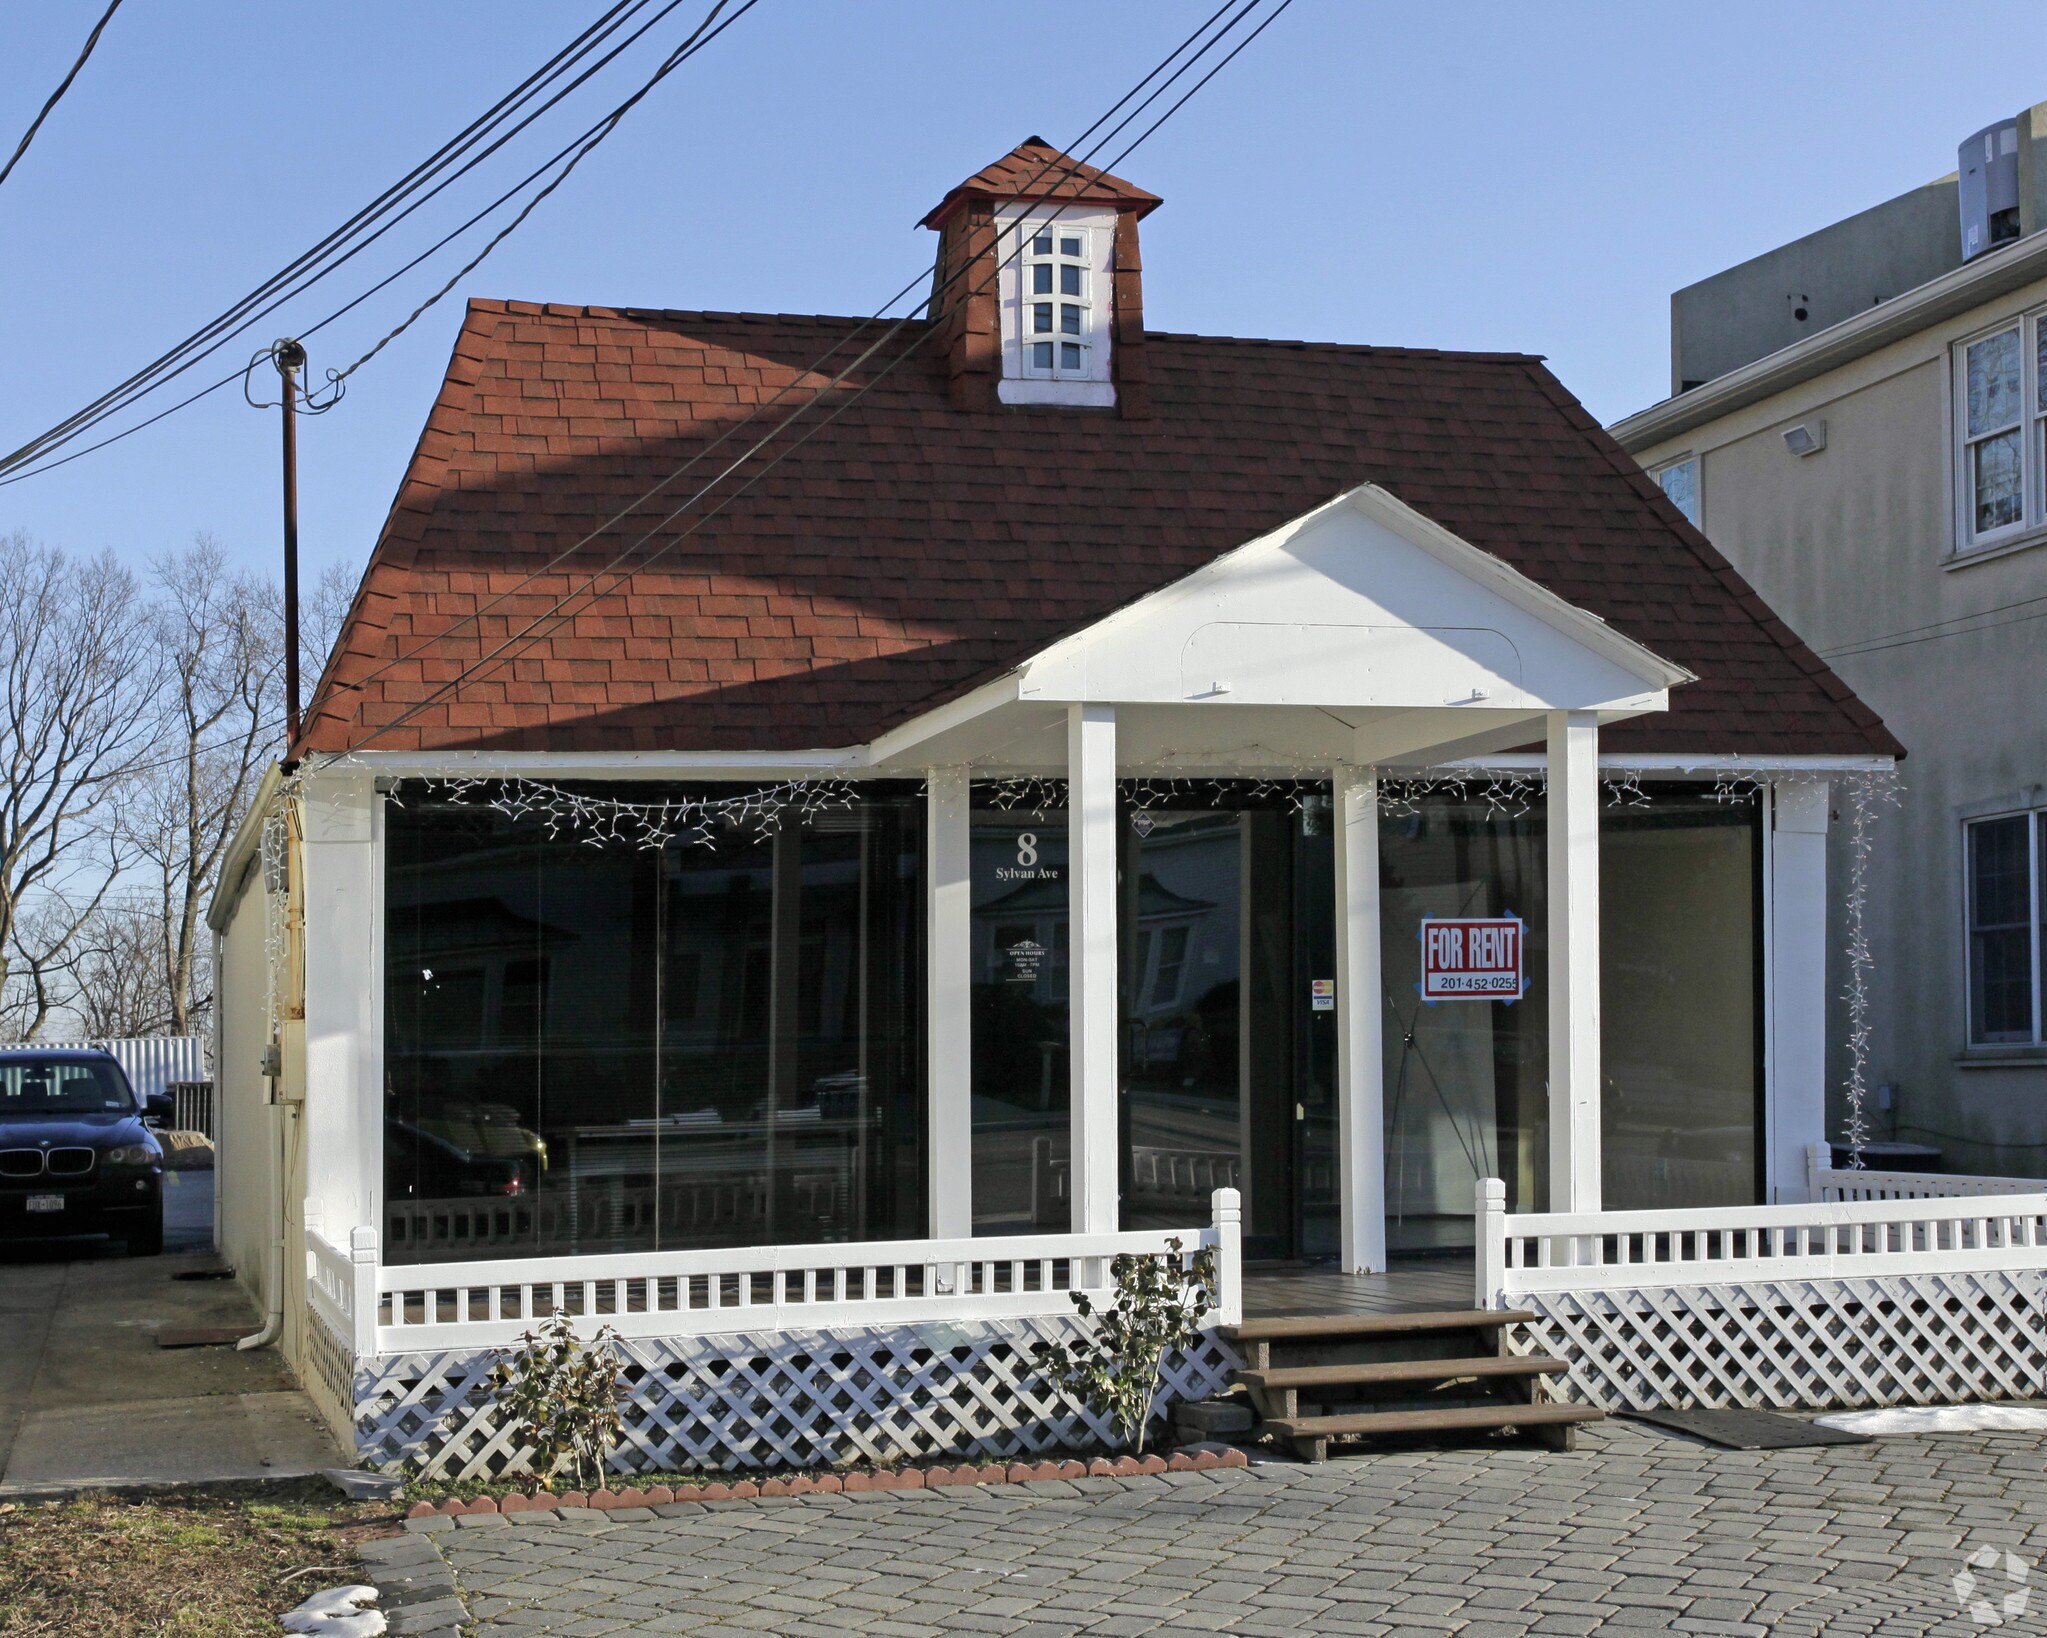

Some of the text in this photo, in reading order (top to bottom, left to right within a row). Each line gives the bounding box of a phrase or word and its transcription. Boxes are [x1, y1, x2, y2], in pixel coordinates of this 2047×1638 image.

[1017, 832, 1038, 866] 8
[996, 867, 1059, 881] Sylvan Ave
[1428, 927, 1516, 969] FOR RENT
